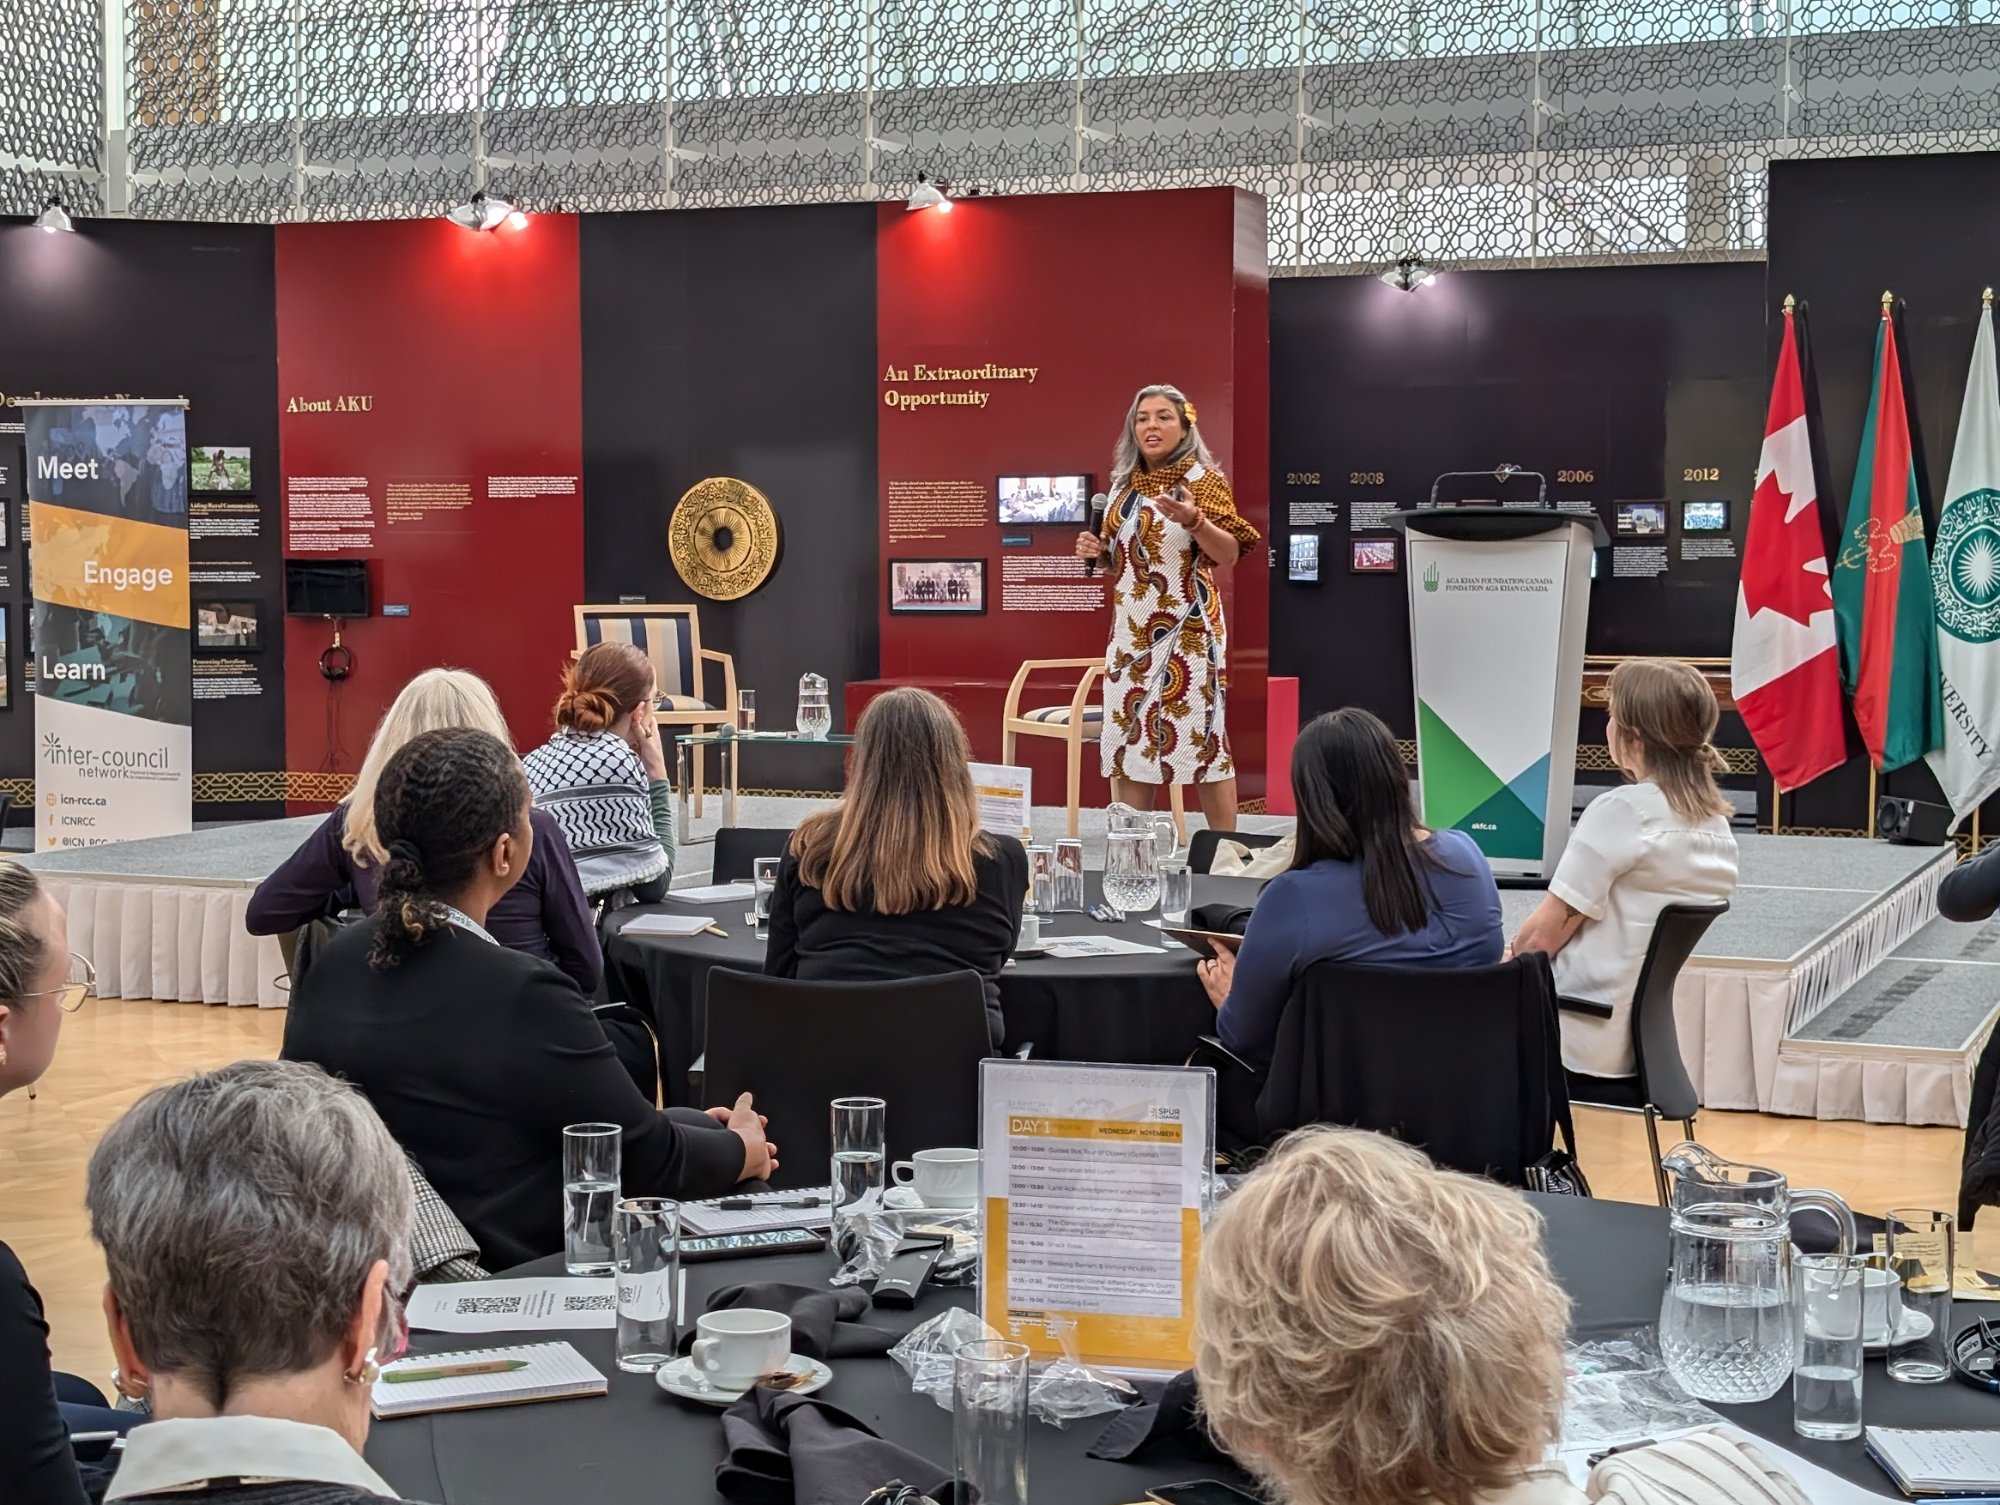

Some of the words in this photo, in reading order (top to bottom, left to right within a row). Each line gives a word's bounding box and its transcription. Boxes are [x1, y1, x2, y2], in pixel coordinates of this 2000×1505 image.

[884, 365, 909, 381] An
[913, 364, 1038, 383] Extraordinary
[286, 397, 332, 413] About
[335, 395, 373, 412] AKU
[885, 390, 990, 410] Opportunity
[37, 456, 99, 480] Meet
[1683, 468, 1720, 482] 2012
[1287, 473, 1320, 485] 2002
[1557, 470, 1594, 483] 2006
[84, 561, 173, 591] Engage
[42, 655, 106, 681] Learn
[1940, 671, 1992, 758] VERSITY
[50, 745, 168, 769] inter-council
[79, 766, 129, 779] network
[61, 794, 107, 806] icn-rcc.ca
[61, 816, 96, 827] ICNRCC
[1471, 821, 1497, 830] akfc.ca
[1158, 1107, 1181, 1115] SPUR
[1012, 1119, 1039, 1133] DAY
[1044, 1121, 1050, 1133] 1
